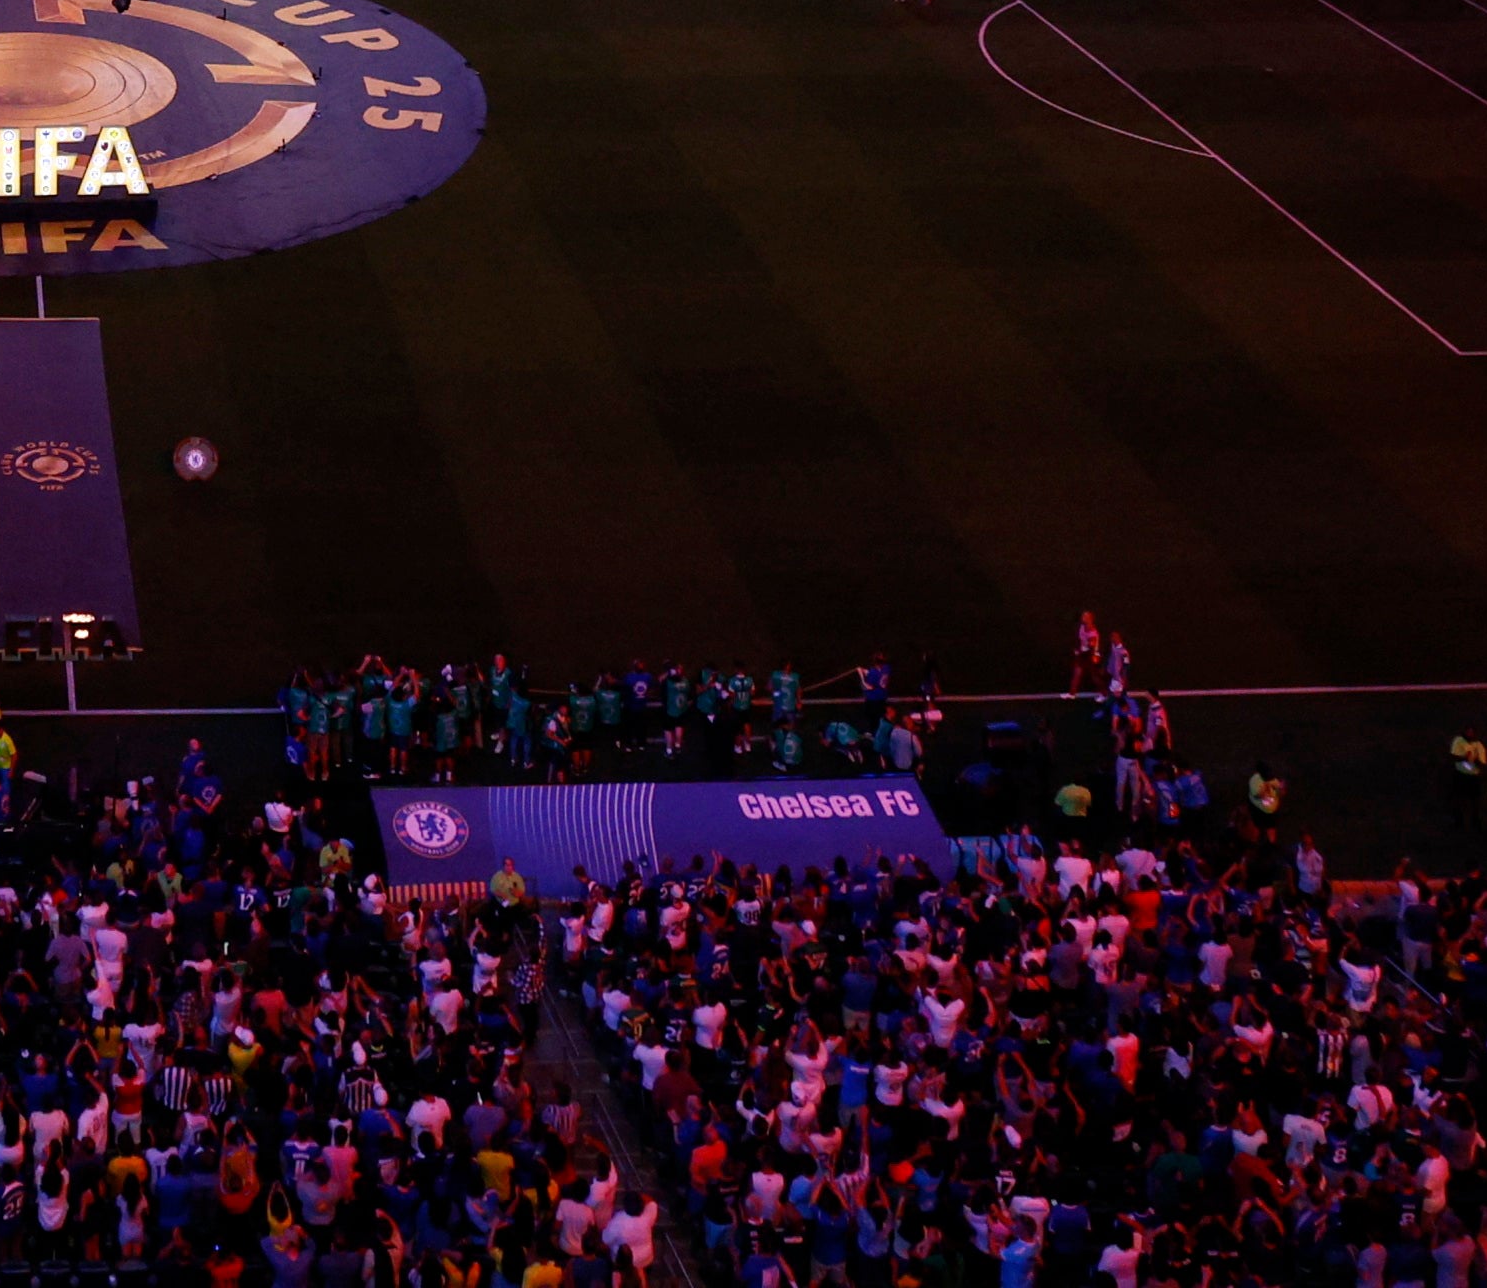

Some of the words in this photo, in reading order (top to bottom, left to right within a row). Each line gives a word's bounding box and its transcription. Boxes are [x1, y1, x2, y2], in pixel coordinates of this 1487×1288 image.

[361, 74, 443, 134] 25
[737, 792, 874, 821] Chelsea
[876, 790, 921, 816] FC
